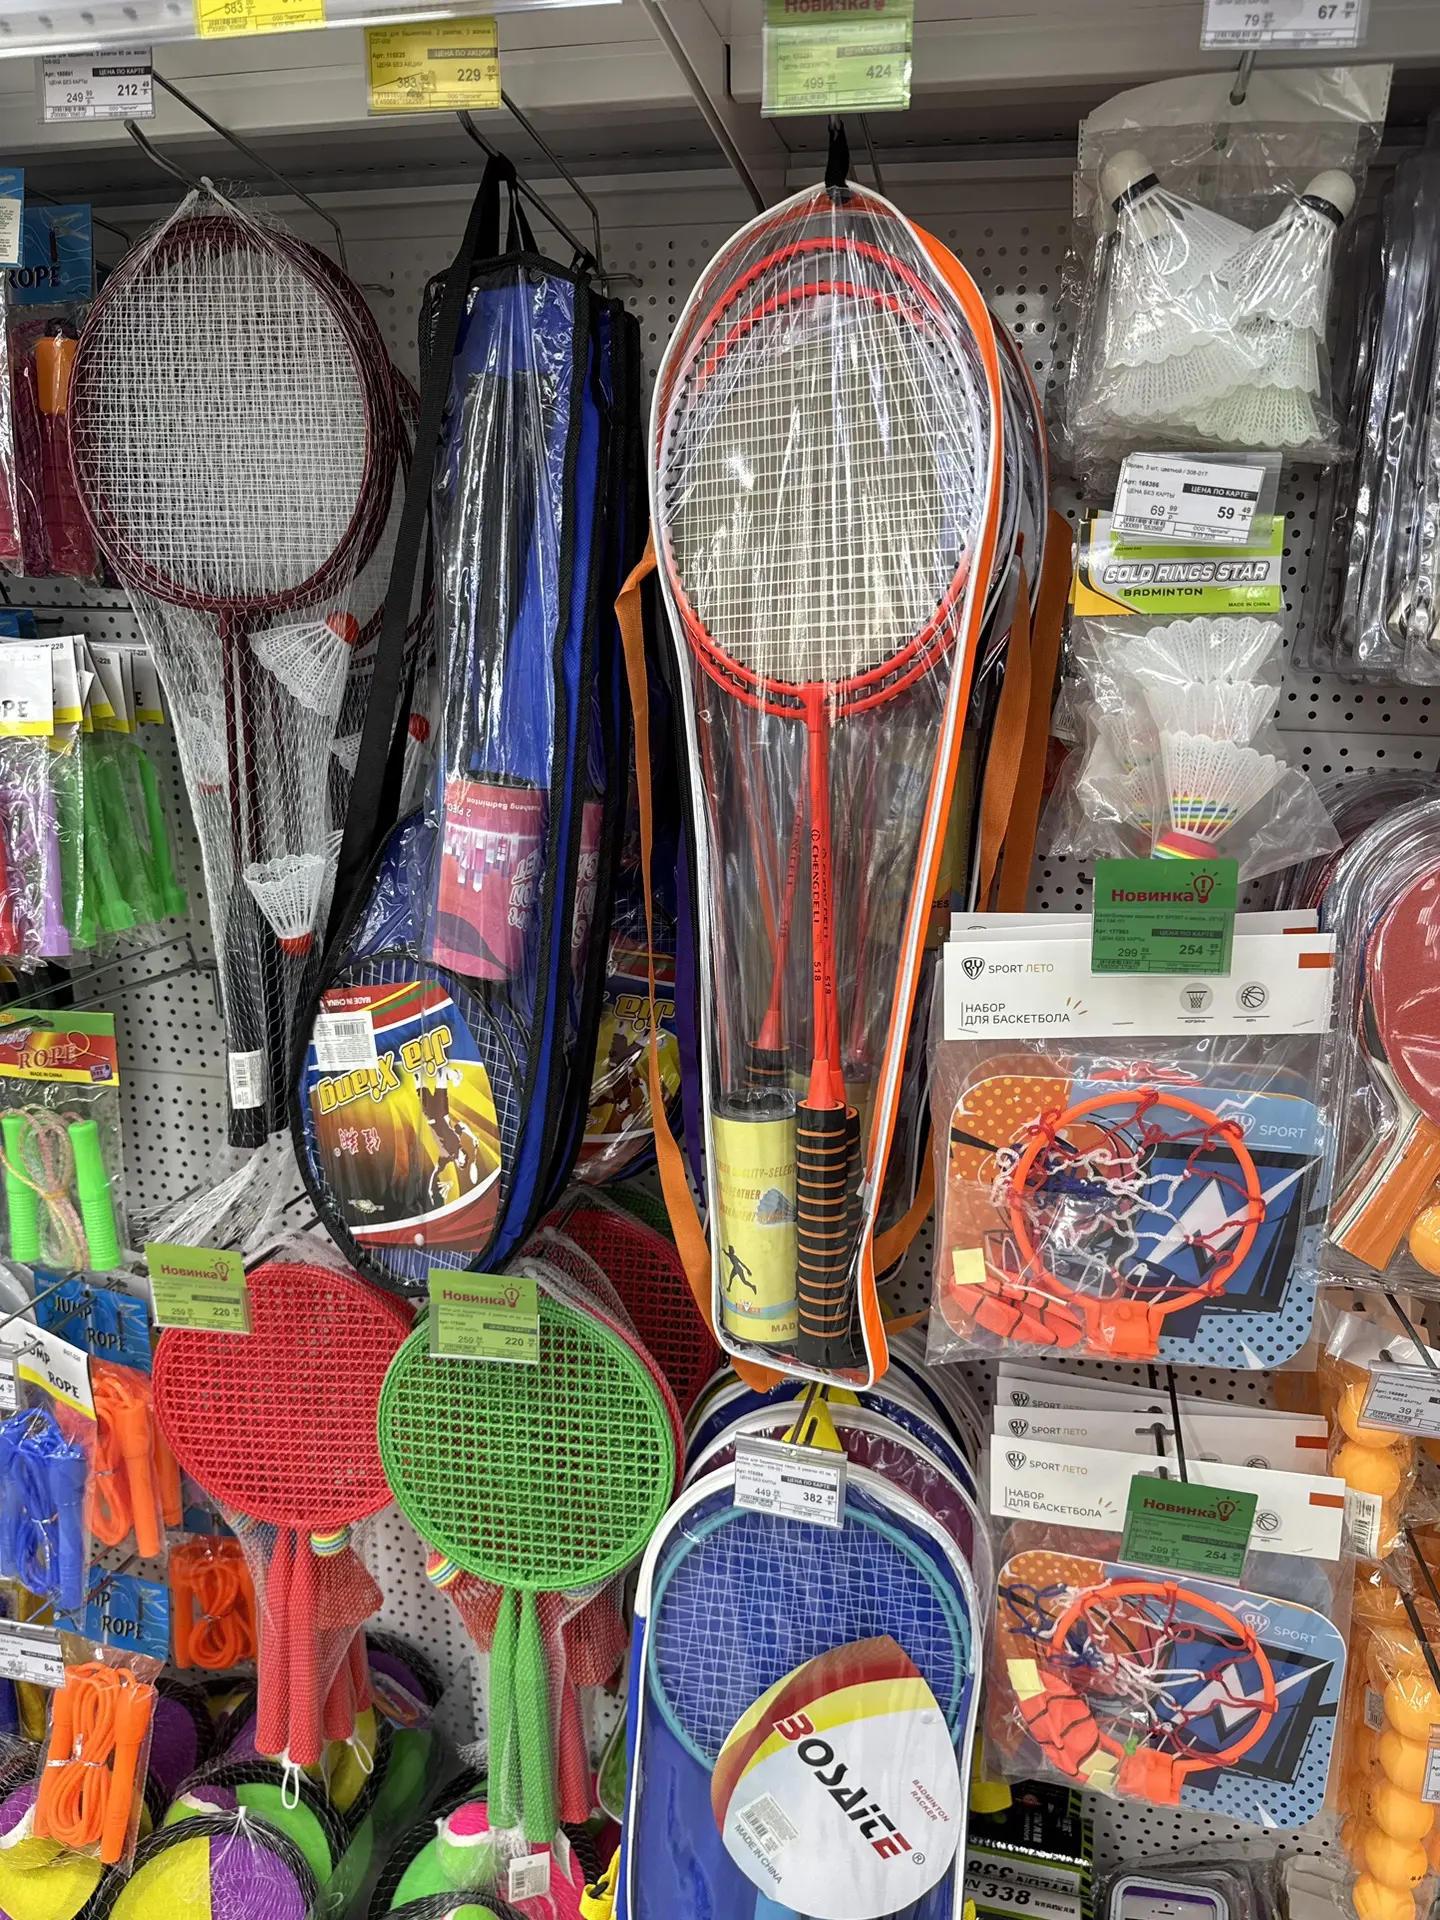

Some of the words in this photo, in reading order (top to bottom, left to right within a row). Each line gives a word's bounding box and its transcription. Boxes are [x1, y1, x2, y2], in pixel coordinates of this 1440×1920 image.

[1318, 5, 1337, 19] 67
[1244, 14, 1260, 27] 79
[126, 67, 145, 75] КАРТЕ
[457, 68, 481, 82] 229
[866, 64, 892, 79] 424
[117, 84, 138, 96] 212
[803, 77, 824, 90] 499
[66, 92, 84, 103] 249
[1155, 490, 1175, 498] КАРТЫ
[1191, 486, 1212, 495] ЦЕНА
[1213, 488, 1225, 496] ПО
[1225, 489, 1250, 499] КАРТЕ
[1150, 505, 1165, 517] 69
[1217, 506, 1235, 520] 59
[1103, 563, 1155, 584] GOLD
[1154, 561, 1217, 583] RINGS
[1215, 560, 1270, 582] STAR
[1123, 587, 1203, 597] BADMINTON
[466, 797, 509, 811] Badminton
[812, 845, 821, 923] CHENGDELI
[1111, 889, 1194, 903] Новинка
[1117, 948, 1138, 957] 299
[1179, 944, 1203, 955] 254
[813, 961, 822, 982] 518
[988, 963, 1023, 974] SPORT
[1025, 962, 1054, 974] ЛЕТО
[326, 998, 346, 1007] CHINA
[353, 996, 371, 1004] MADE
[965, 1003, 1006, 1013] НАБОР
[965, 1015, 989, 1027] ДЛЯ
[992, 1013, 1070, 1025] БАСКЕТБОЛА
[18, 1044, 77, 1070] ROPE
[402, 1025, 453, 1077] Jia
[318, 1051, 400, 1115] Xiang
[1259, 1124, 1307, 1138] SPORT
[161, 1264, 218, 1280] Новинка
[442, 1289, 506, 1306] Новинка
[213, 1307, 230, 1316] 220
[771, 1322, 798, 1332] MAD
[86, 1327, 127, 1352] ROPE
[505, 1337, 524, 1346] 220
[48, 1371, 80, 1399] ROPE
[1398, 1407, 1412, 1415] 39
[1031, 1426, 1061, 1435] SPORT
[1063, 1427, 1088, 1436] ЛЕТО
[1029, 1460, 1060, 1472] SPORT
[1062, 1464, 1088, 1475] ЛЕТО
[786, 1477, 803, 1485] ЦЕНА
[755, 1488, 771, 1497] 449
[803, 1492, 823, 1504] 382
[1008, 1488, 1045, 1500] НАБОР
[1008, 1497, 1031, 1510] ДЛЯ
[1032, 1501, 1102, 1518] БАСКЕТБОЛА
[1143, 1498, 1217, 1519] Новинка
[1150, 1545, 1169, 1554] 299
[1204, 1550, 1227, 1560] 254
[101, 1615, 144, 1640] ROPE
[1273, 1626, 1317, 1644] SPORT
[44, 1664, 54, 1673] 84
[909, 1790, 938, 1821] RACKER
[912, 1779, 949, 1822] BADMINTON
[734, 1824, 755, 1848] MADE
[760, 1856, 783, 1884] CHINA
[982, 1883, 1032, 1905] 338
